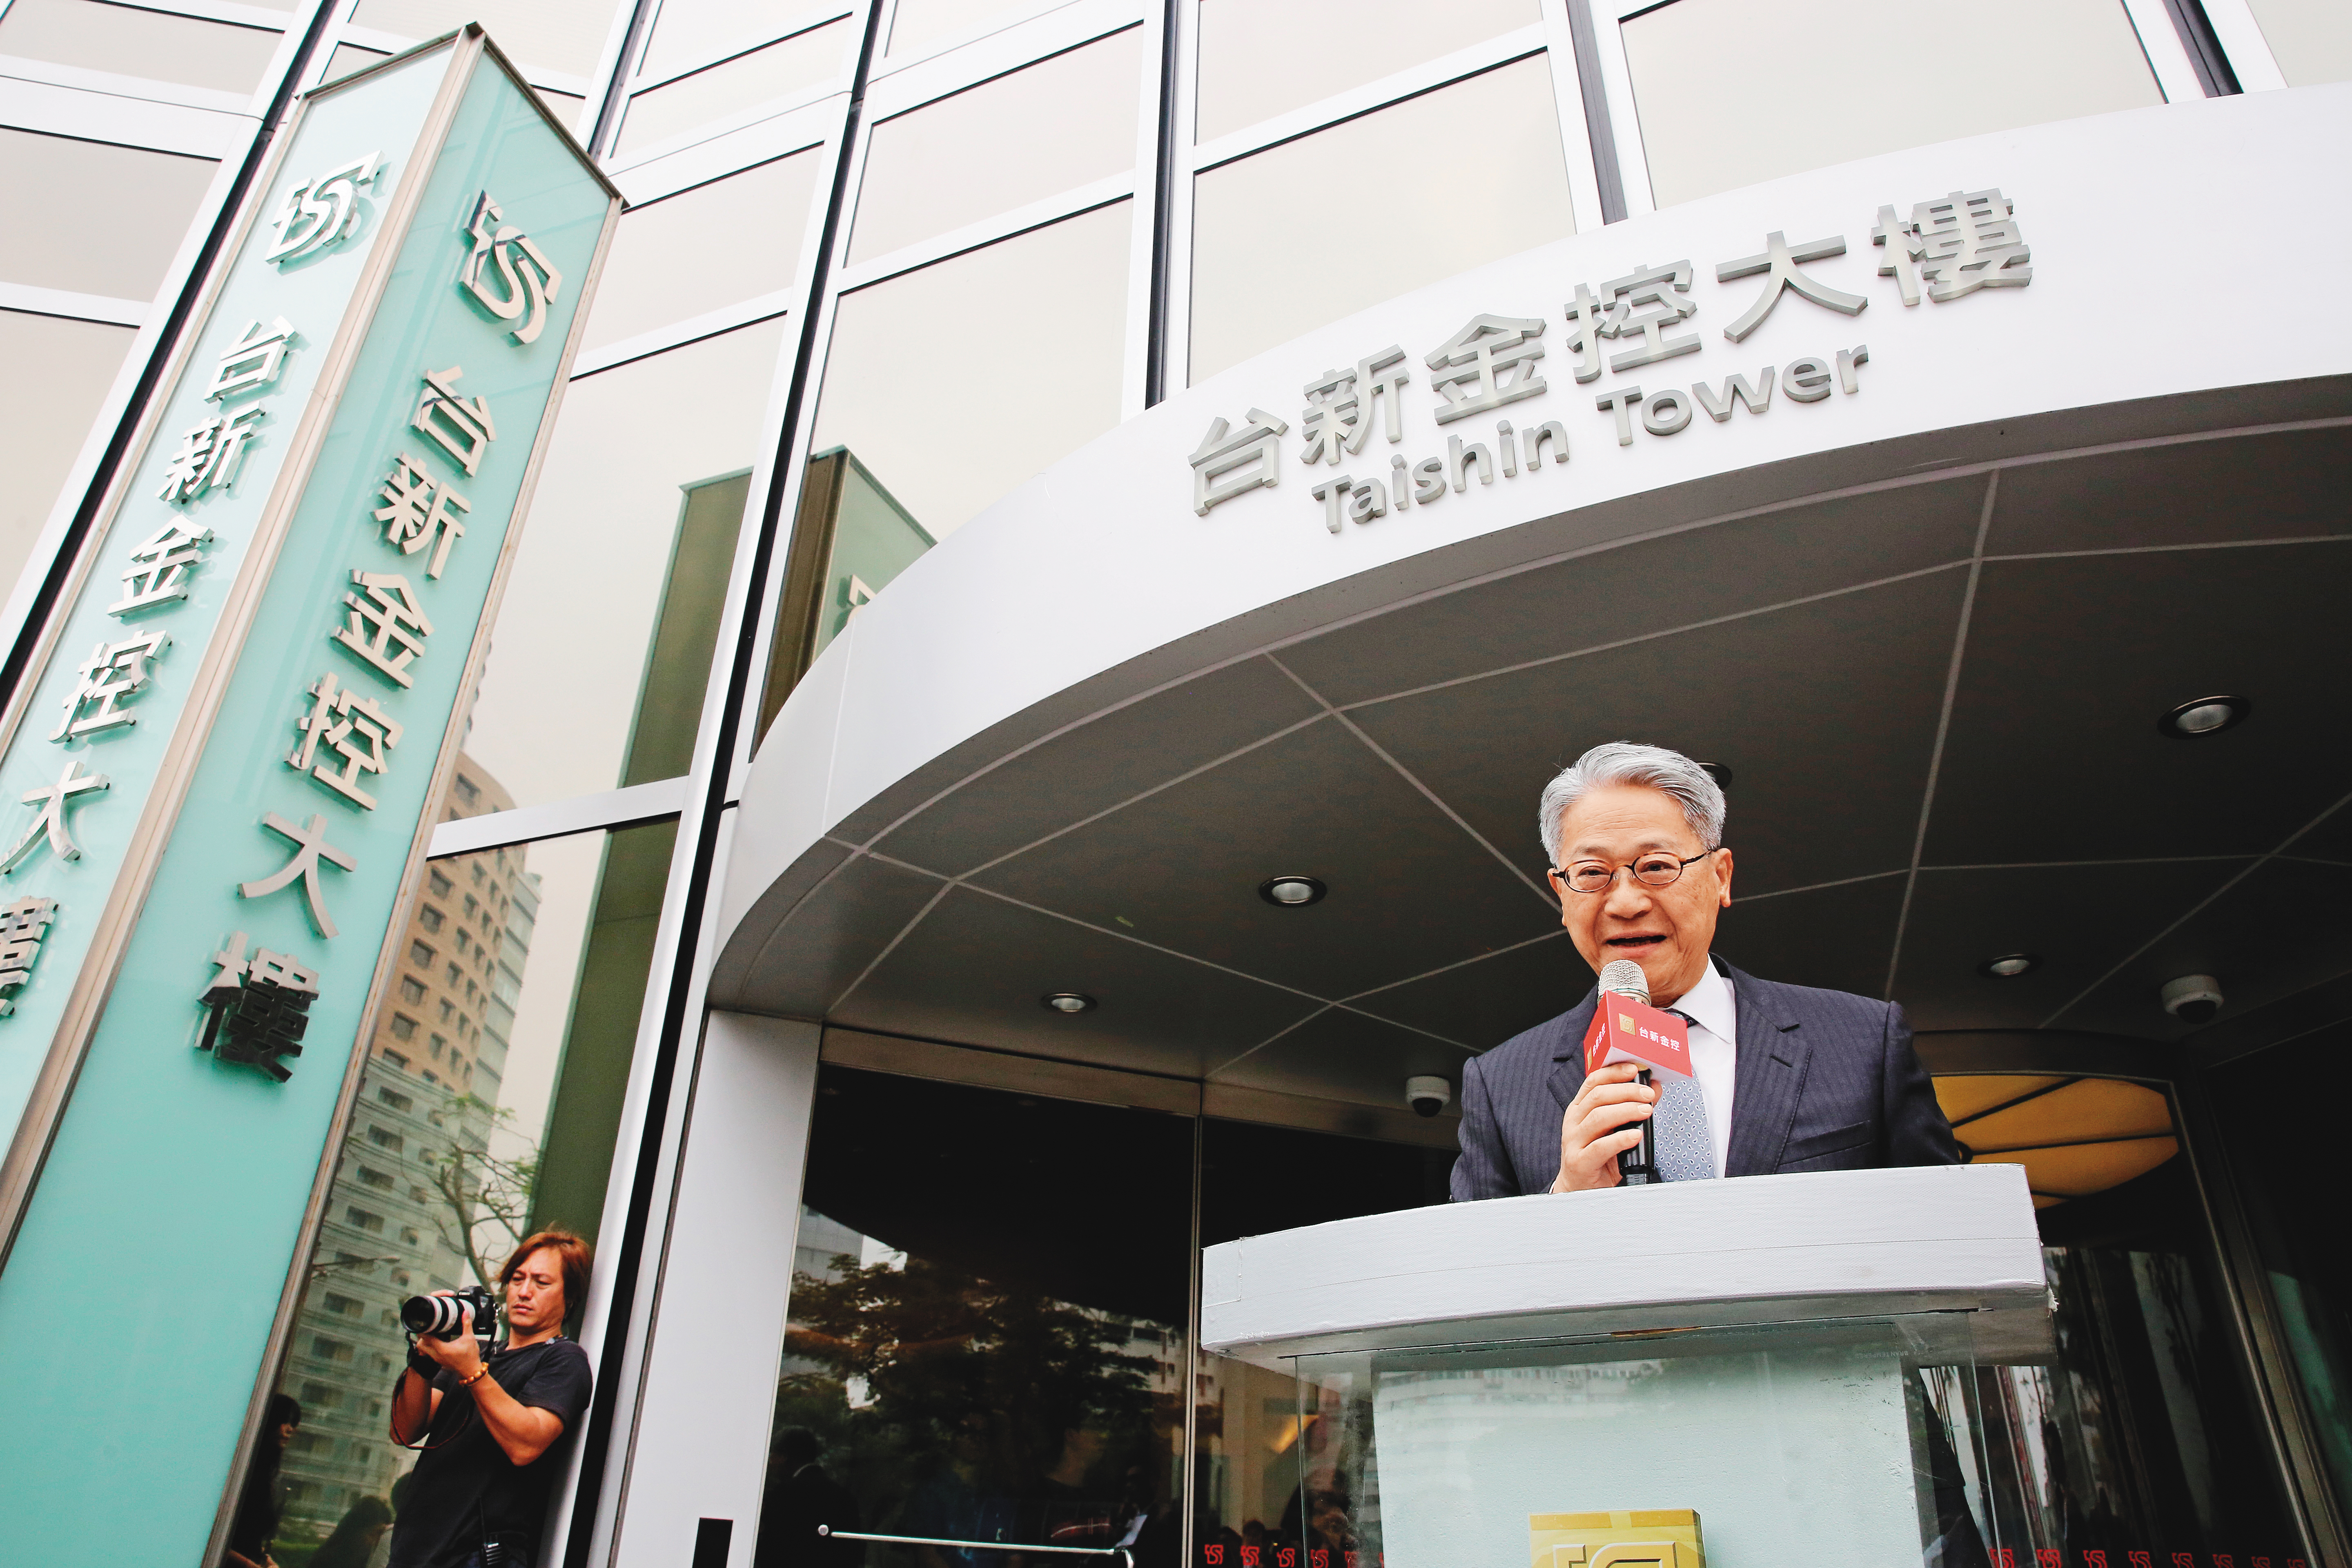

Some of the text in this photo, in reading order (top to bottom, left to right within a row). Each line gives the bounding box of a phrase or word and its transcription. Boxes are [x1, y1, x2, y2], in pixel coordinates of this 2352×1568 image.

[1188, 187, 2034, 517] 台新金控大樓
[1312, 344, 1869, 533] Taishin Tower
[194, 365, 497, 1083] 台新金控大樓
[1639, 1026, 1680, 1051] 台新金控
